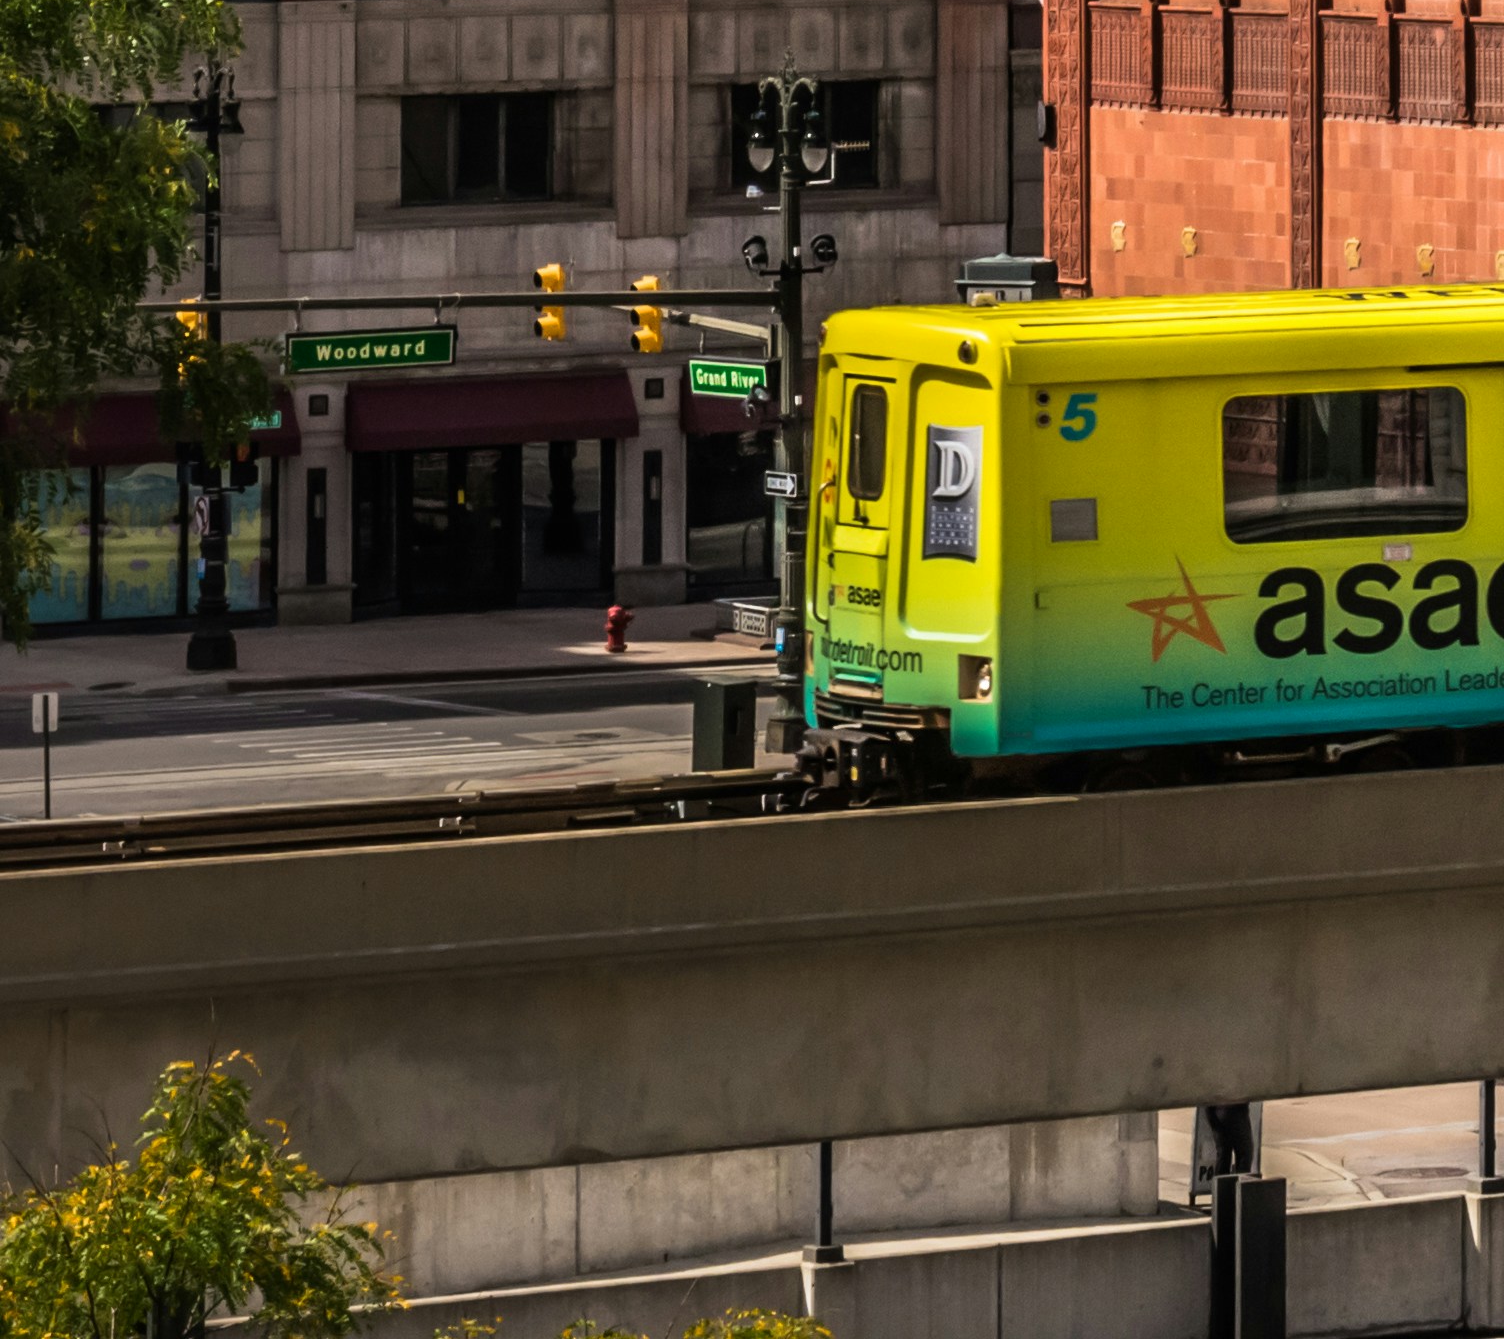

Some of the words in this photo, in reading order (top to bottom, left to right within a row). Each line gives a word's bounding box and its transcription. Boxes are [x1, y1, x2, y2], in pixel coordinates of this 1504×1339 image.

[316, 339, 426, 362] Woodward
[696, 368, 727, 387] Grand
[731, 371, 760, 389] River
[1060, 392, 1098, 442] 5
[932, 440, 975, 497] D
[847, 584, 881, 608] asae
[1142, 685, 1185, 710] The
[1192, 677, 1268, 708] Center
[1275, 676, 1305, 703] for
[1312, 670, 1437, 701] Association
